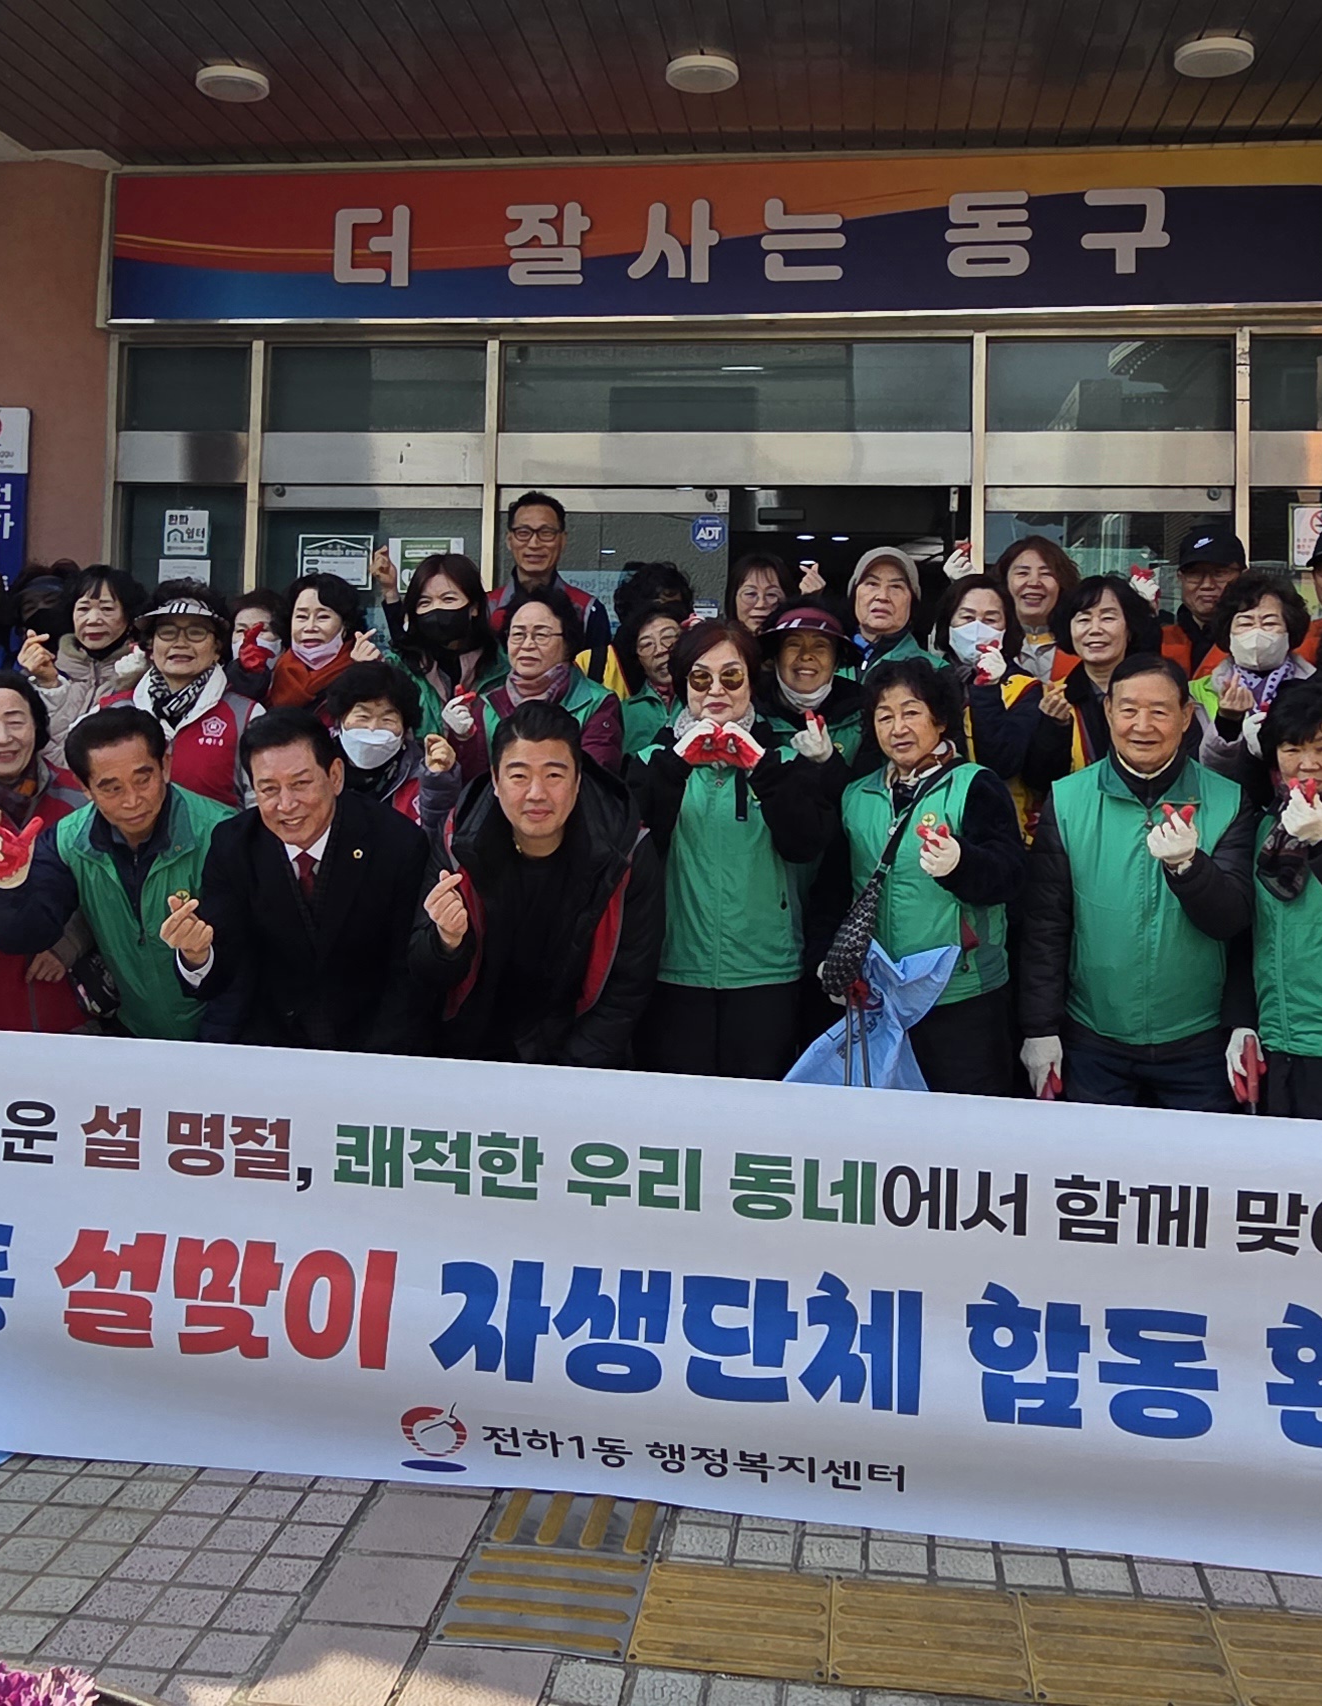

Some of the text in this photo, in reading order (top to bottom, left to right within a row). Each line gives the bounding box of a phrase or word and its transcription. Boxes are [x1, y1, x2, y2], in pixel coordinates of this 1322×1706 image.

[335, 190, 1169, 286] 더 잘사는 동구
[696, 526, 722, 541] ADT
[81, 1105, 141, 1170] 설
[168, 1111, 313, 1192] 명절,
[334, 1124, 543, 1200] 쾌적한
[568, 1143, 701, 1212] 우리
[730, 1153, 1028, 1236] 동네에서
[1055, 1175, 1209, 1249] 함께
[55, 1229, 397, 1370] 설맞이
[429, 1260, 922, 1416] 자생단체
[966, 1282, 1219, 1439] 합동
[482, 1426, 905, 1492] 전하1동 행정복지센터
